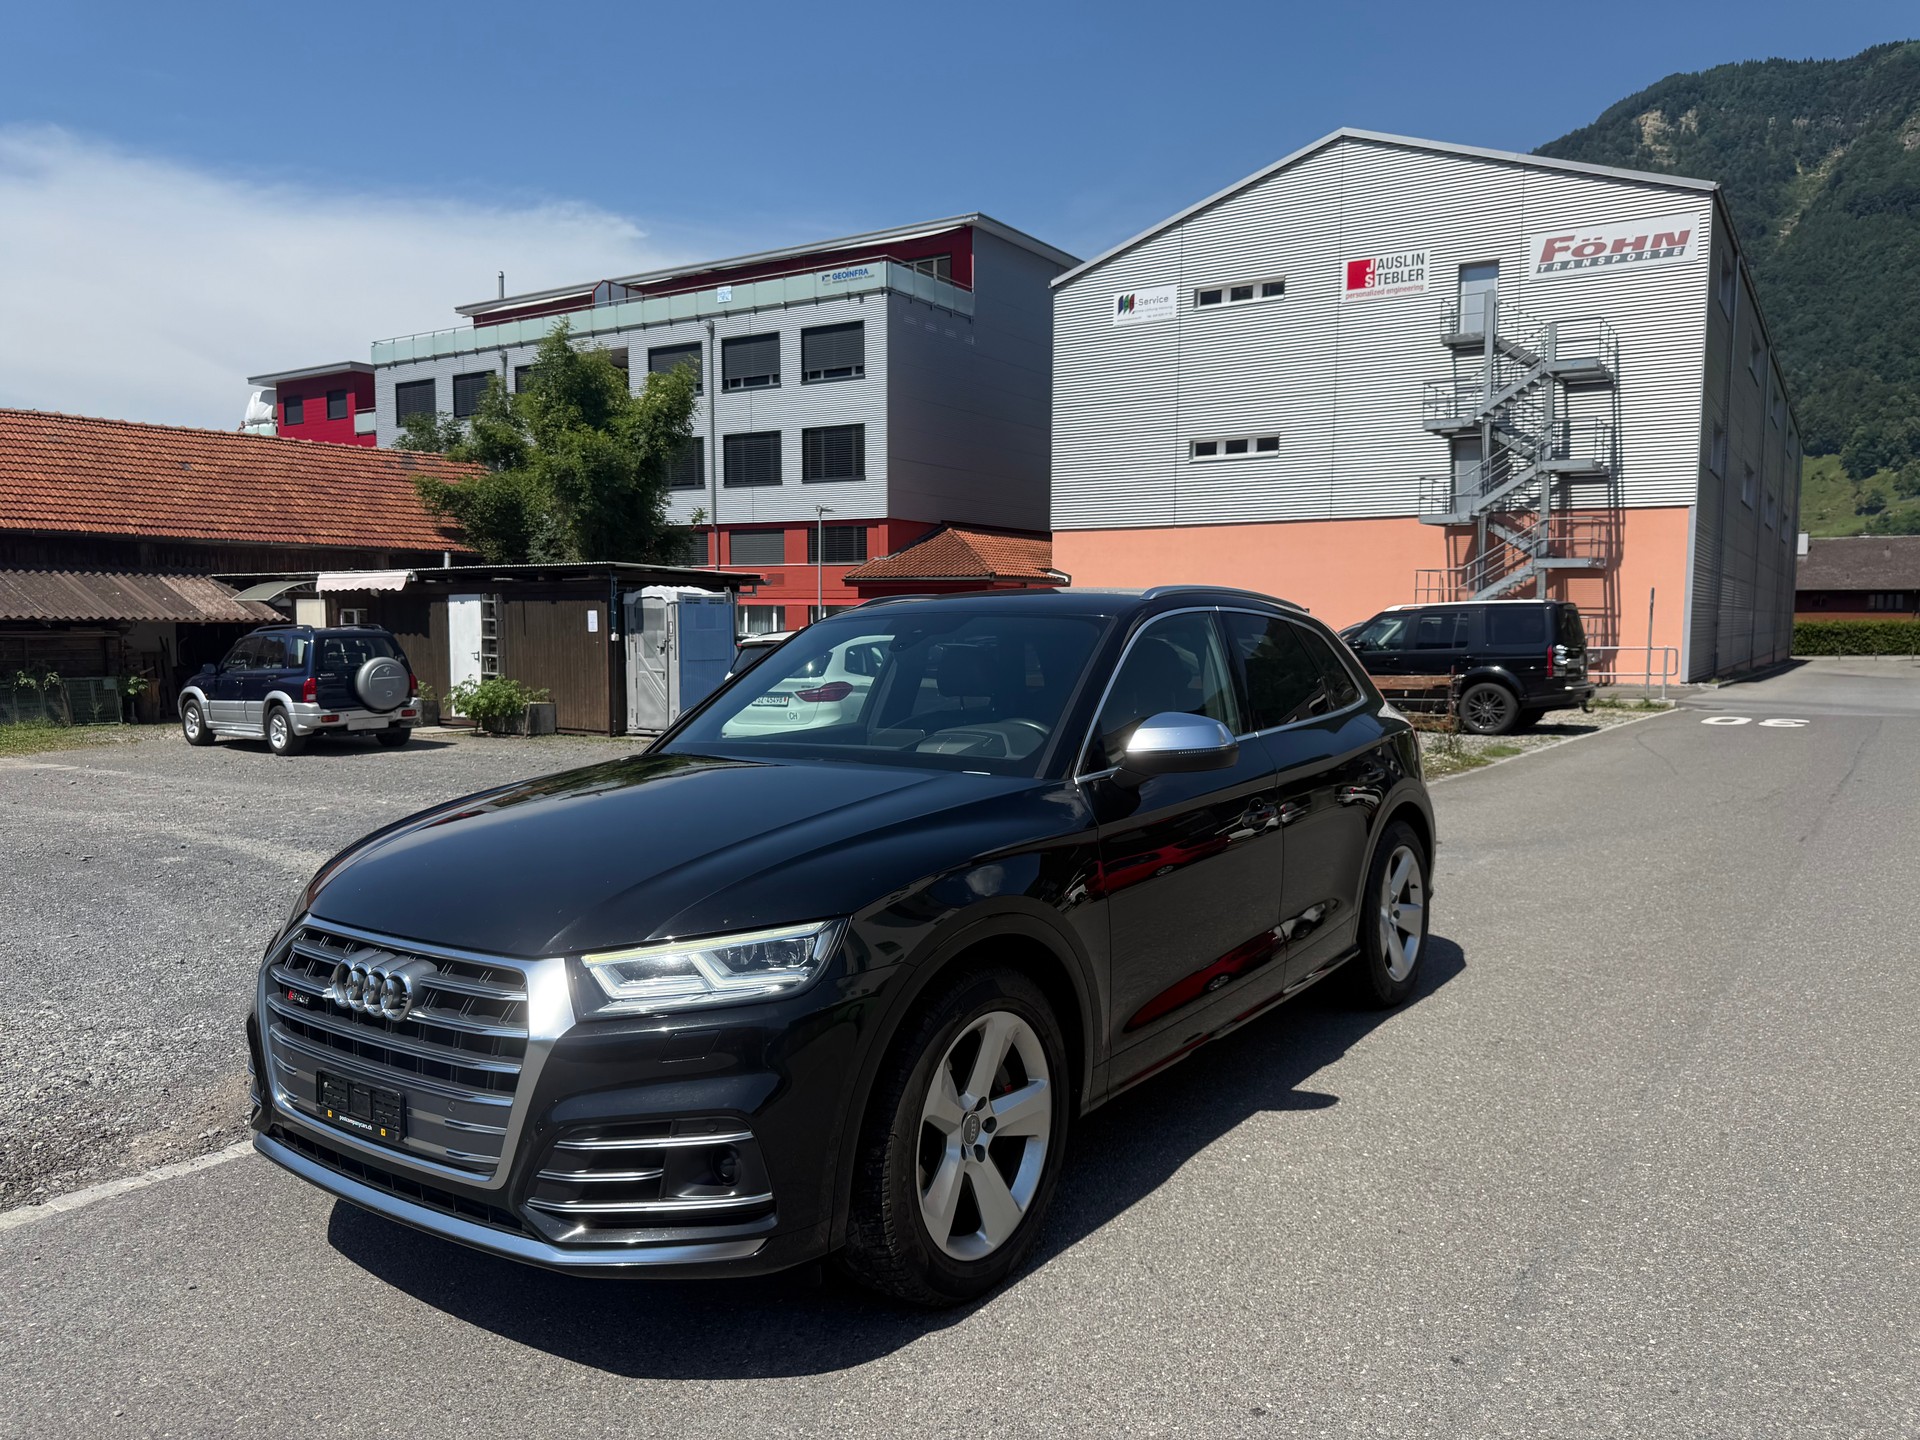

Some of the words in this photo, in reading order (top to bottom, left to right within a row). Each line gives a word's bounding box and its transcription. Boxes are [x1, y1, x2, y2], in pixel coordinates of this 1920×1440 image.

[1539, 229, 1691, 263] FÖHN
[1538, 247, 1684, 273] TRANSPORTE
[832, 268, 869, 280] GEOINFRA
[1345, 288, 1385, 300] personalized
[1386, 284, 1424, 295] engineering
[788, 712, 798, 721] CH
